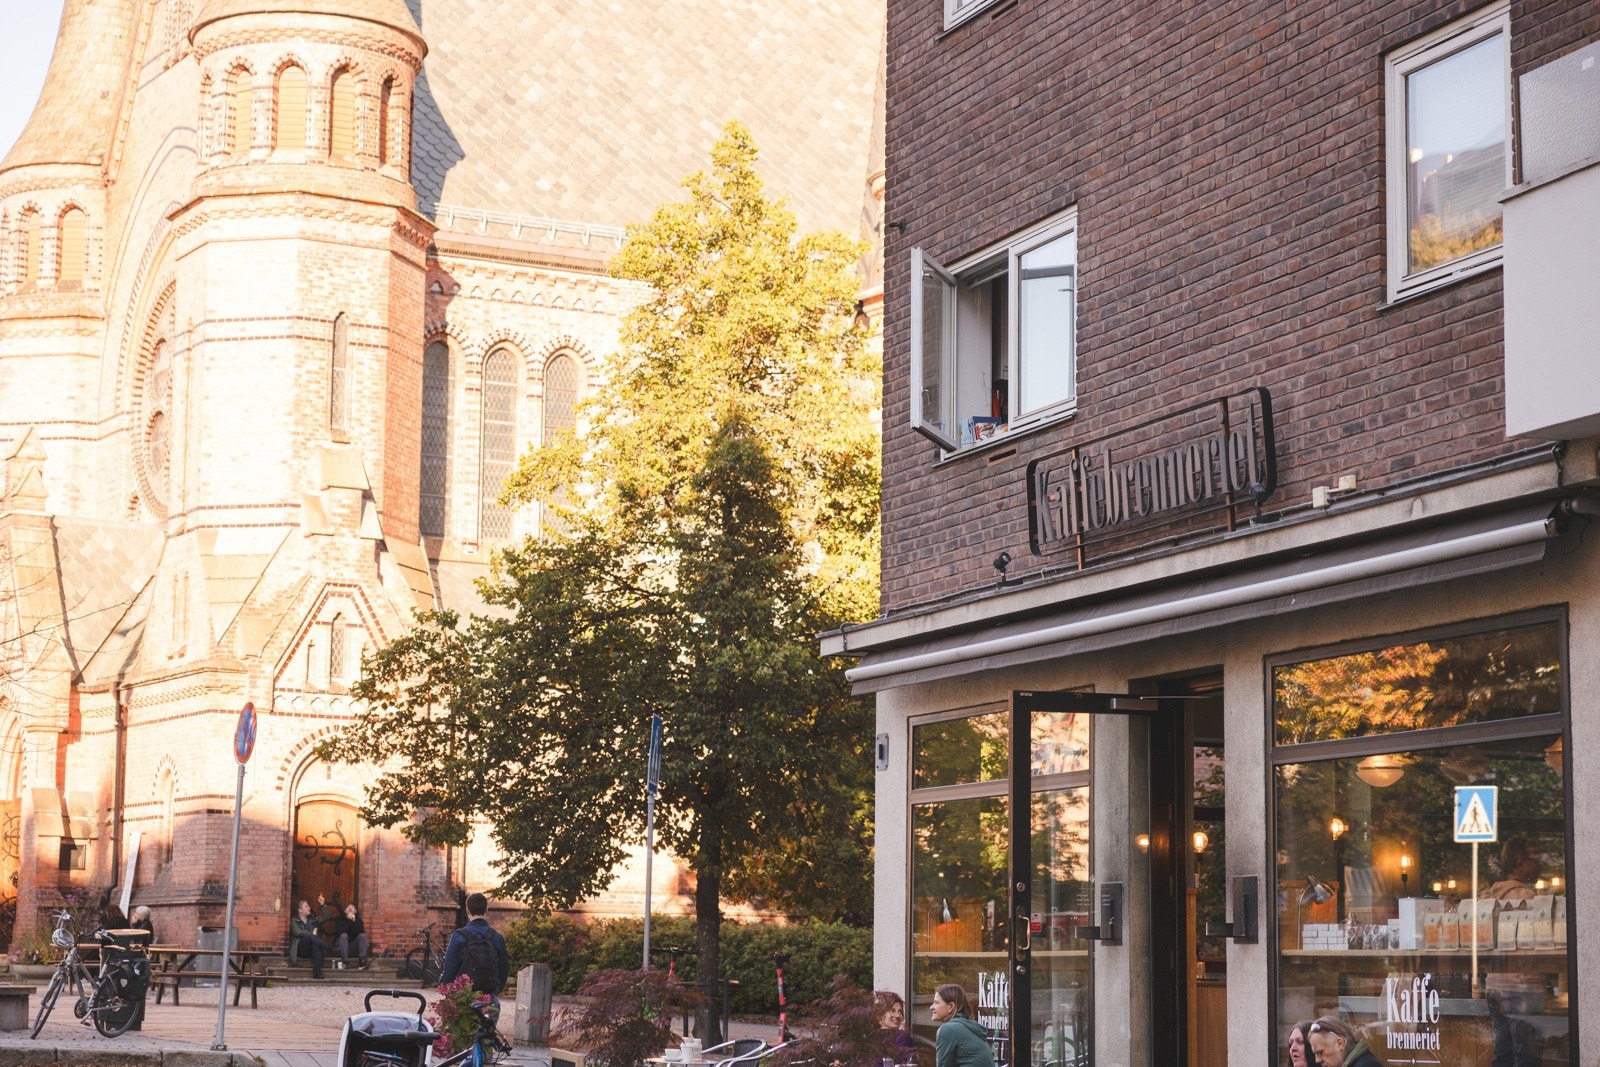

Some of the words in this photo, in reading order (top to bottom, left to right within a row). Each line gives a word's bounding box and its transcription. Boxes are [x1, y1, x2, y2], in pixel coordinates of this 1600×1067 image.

[1034, 402, 1264, 545] Kaffebrenneriet
[1385, 976, 1440, 1024] Kaffe
[1386, 1026, 1441, 1050] brenneriet
